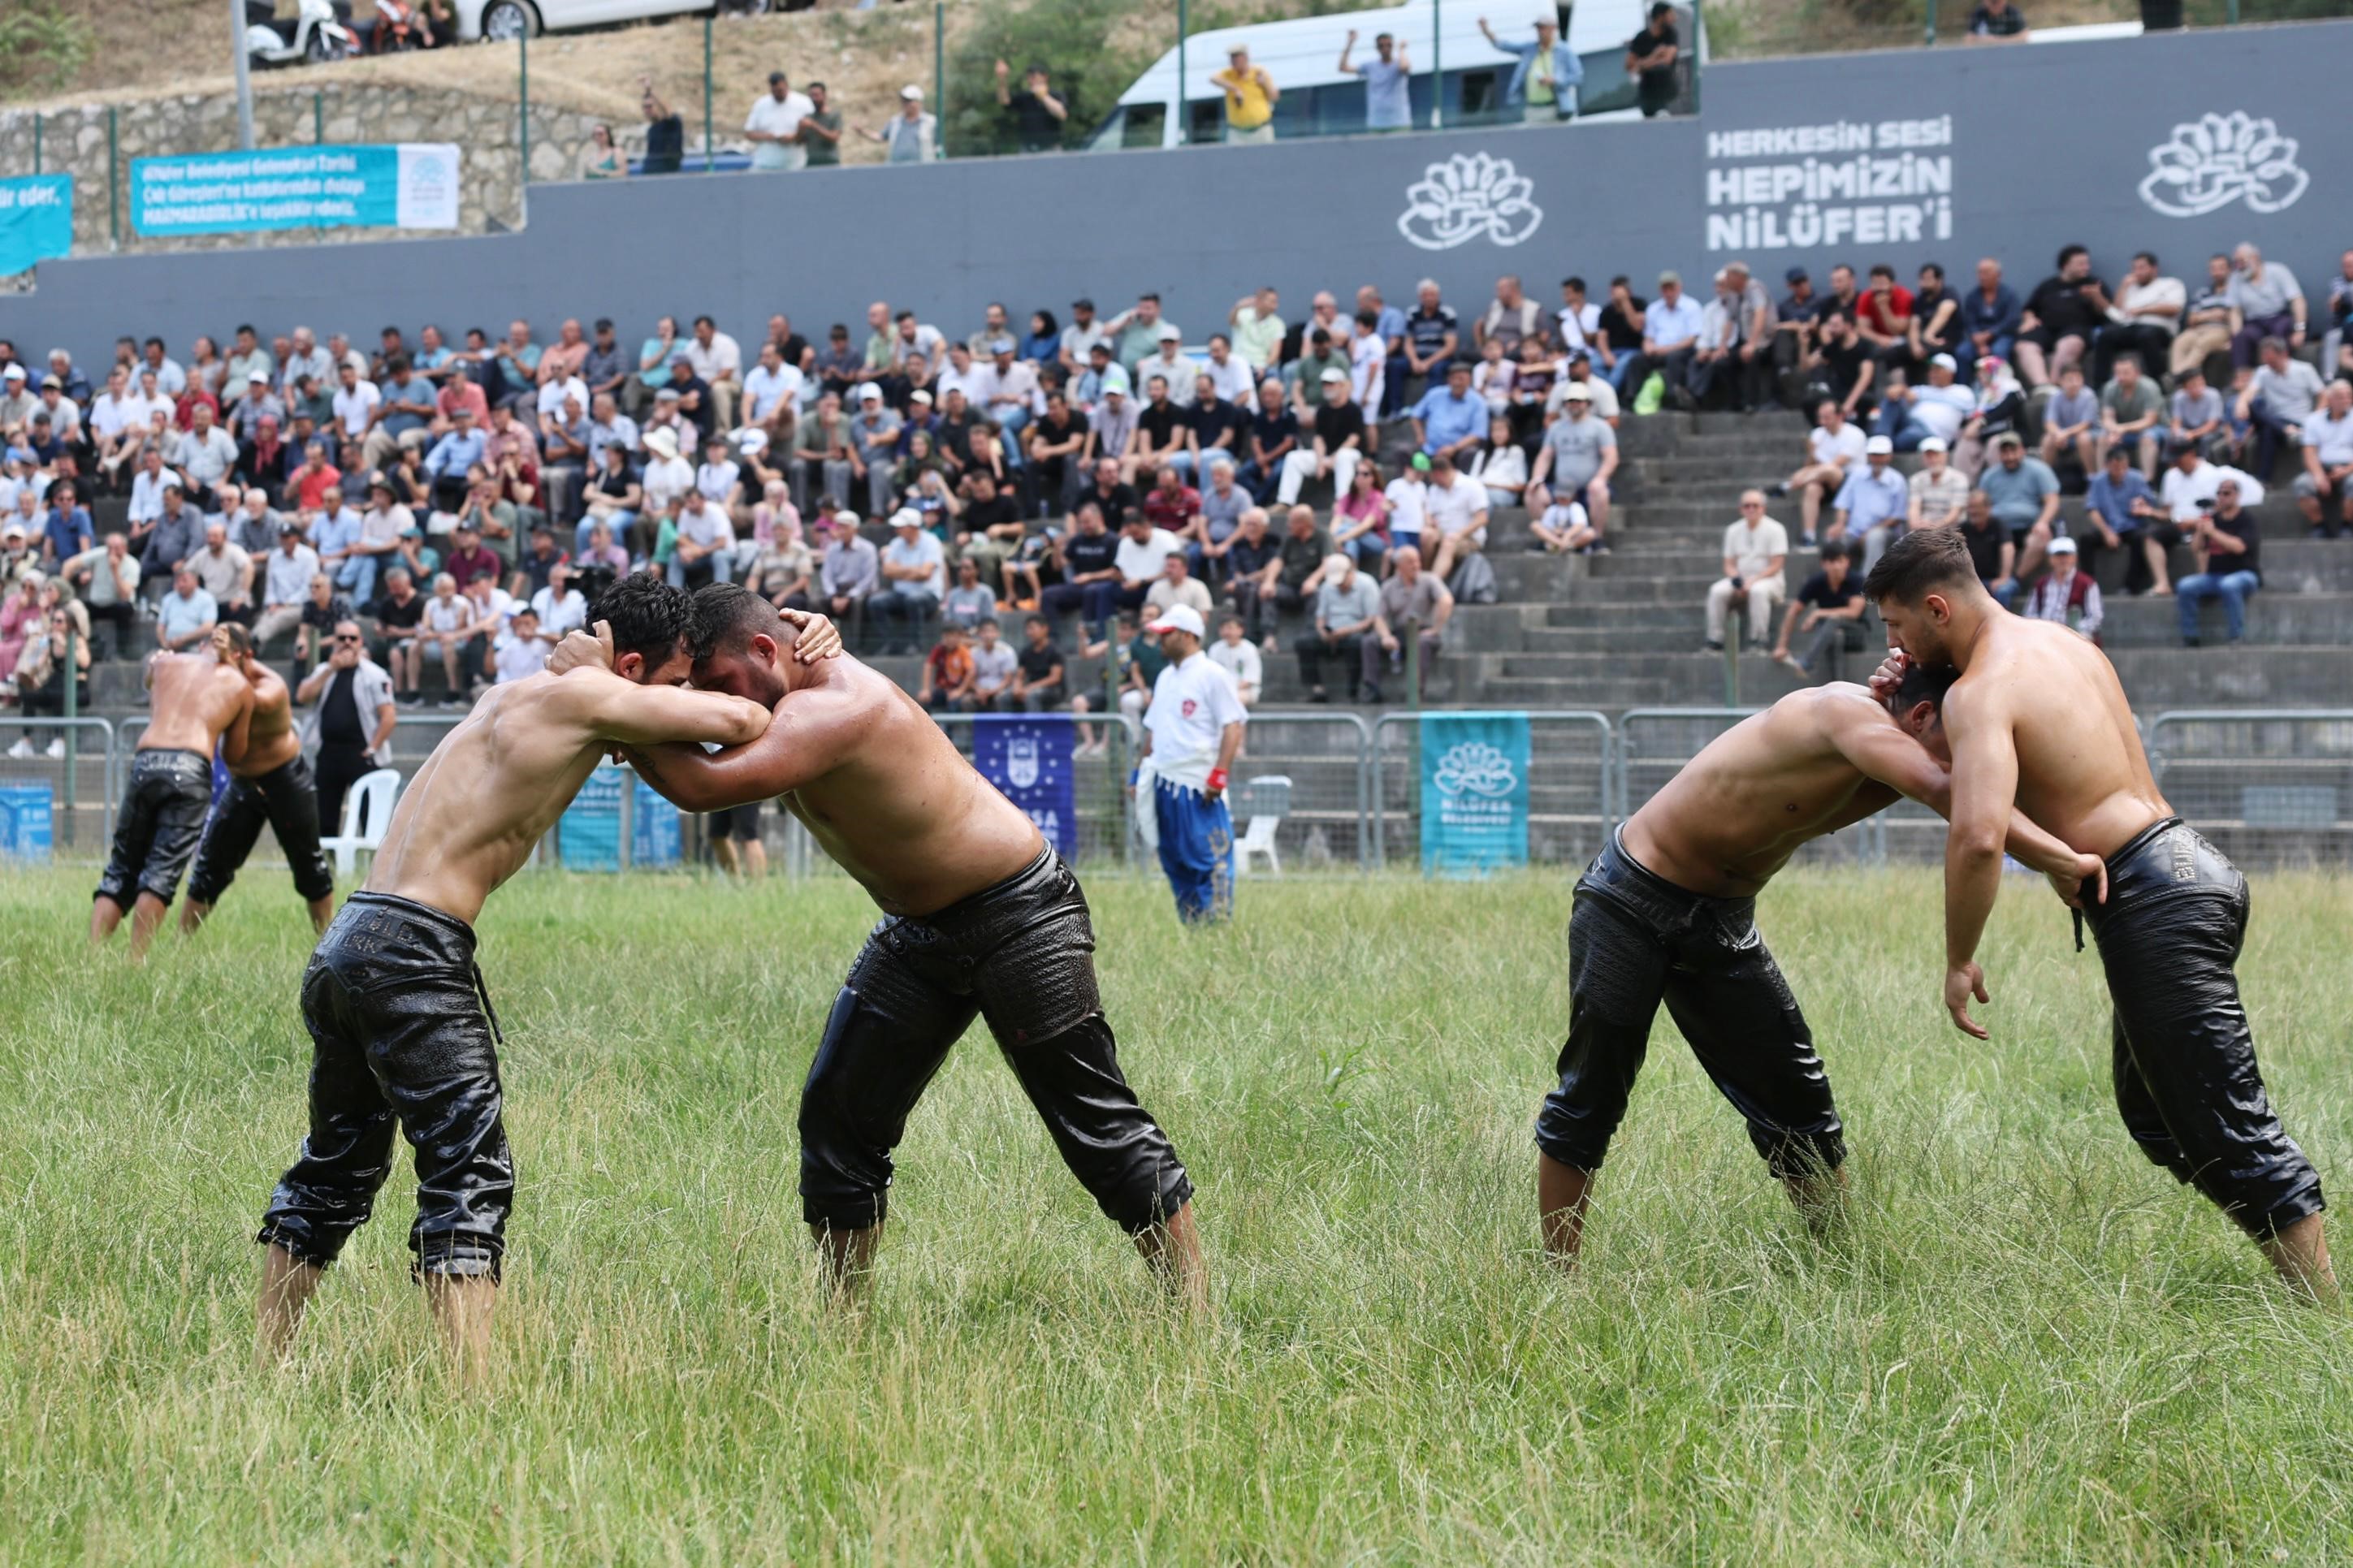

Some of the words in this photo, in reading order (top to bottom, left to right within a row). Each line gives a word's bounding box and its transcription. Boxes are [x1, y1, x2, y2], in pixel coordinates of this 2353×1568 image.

[1707, 119, 1871, 159] HERKESİN
[1876, 114, 1952, 149] SESİ
[1707, 151, 1953, 206] HEPİMİZİN
[1707, 195, 1953, 252] NİLÜFER'İ
